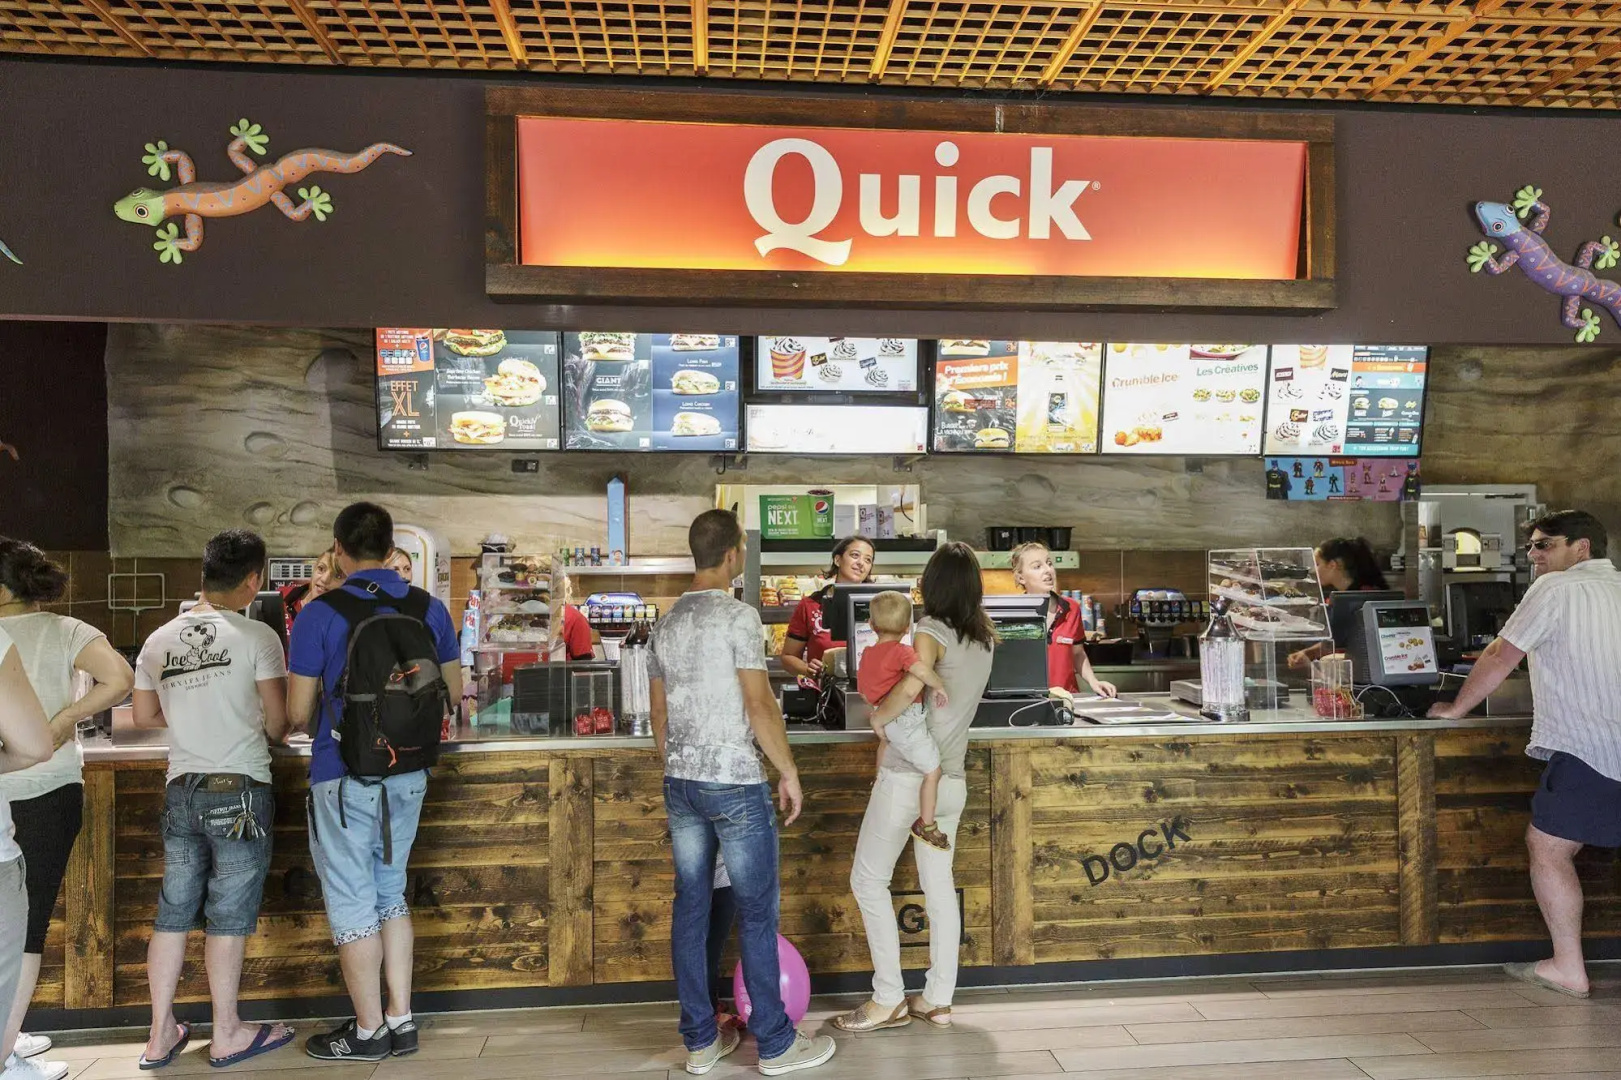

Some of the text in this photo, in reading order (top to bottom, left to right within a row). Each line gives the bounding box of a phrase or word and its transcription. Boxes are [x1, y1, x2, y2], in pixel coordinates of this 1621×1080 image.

[744, 137, 1093, 266] Quick
[1112, 373, 1178, 388] Crumble Ice
[1196, 367, 1213, 376] Les
[390, 381, 418, 392] EFFET
[391, 392, 420, 417] XL
[767, 510, 798, 525] NEXT
[162, 648, 229, 669] Joe Cool
[1081, 814, 1193, 888] DOCK
